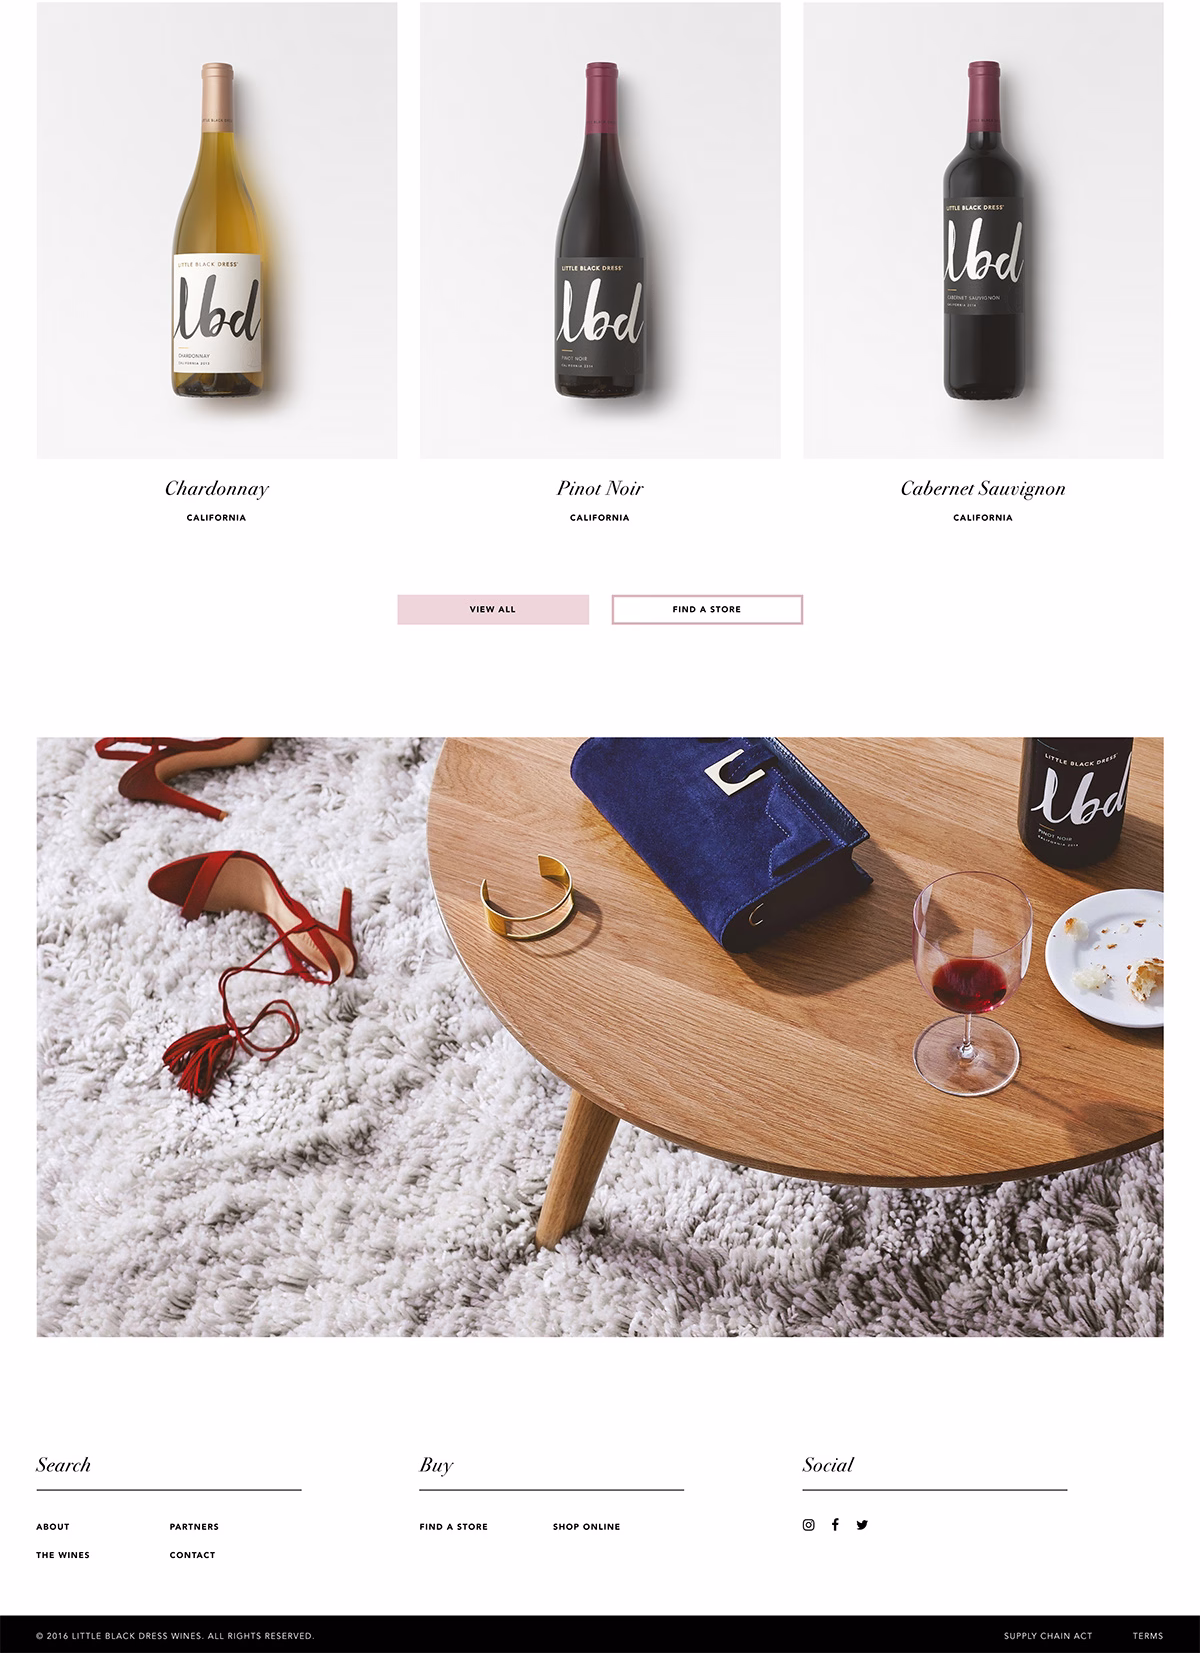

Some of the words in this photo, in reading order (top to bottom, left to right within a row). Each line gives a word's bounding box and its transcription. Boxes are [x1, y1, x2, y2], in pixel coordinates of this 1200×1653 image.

[165, 479, 270, 501] Chardonnay
[555, 479, 602, 496] Pinot
[604, 479, 645, 496] Noir
[900, 479, 975, 496] Cabernet
[977, 479, 1066, 501] Sauvignon
[186, 513, 247, 522] CALIFORNIA
[569, 513, 630, 522] CALIFORNIA
[952, 513, 1013, 522] CALIFORNIA
[469, 605, 495, 614] VIEW
[497, 605, 516, 614] ALL
[672, 605, 697, 614] FIND
[699, 605, 707, 614] A
[709, 605, 741, 614] STORE
[1044, 752, 1068, 766] LITTLE
[1096, 754, 1117, 766] DRESS
[35, 1456, 91, 1473] Search
[418, 1456, 455, 1478] Buy
[801, 1456, 856, 1473] Social
[35, 1522, 70, 1531] ABOUT
[169, 1522, 219, 1531] PARTNERS
[419, 1522, 444, 1531] FIND
[446, 1523, 454, 1531] A
[456, 1522, 488, 1531] STORE
[552, 1522, 580, 1531] SHOP
[582, 1522, 621, 1531] ONLINE
[35, 1551, 55, 1559] THE
[57, 1551, 90, 1559] WINES
[169, 1551, 216, 1559] CONTACT
[46, 1631, 69, 1640] 2016
[71, 1631, 102, 1640] LITTLE
[104, 1631, 136, 1640] BLACK
[138, 1631, 168, 1640] DRESS
[170, 1631, 205, 1640] WINES.
[207, 1632, 225, 1640] ALL
[227, 1631, 262, 1640] RIGHTS
[264, 1631, 315, 1640] RESERVED.
[1003, 1631, 1038, 1640] SUPPLY
[1039, 1631, 1071, 1640] CHAIN
[1073, 1631, 1093, 1640] ACT
[1132, 1631, 1164, 1640] TERMS
